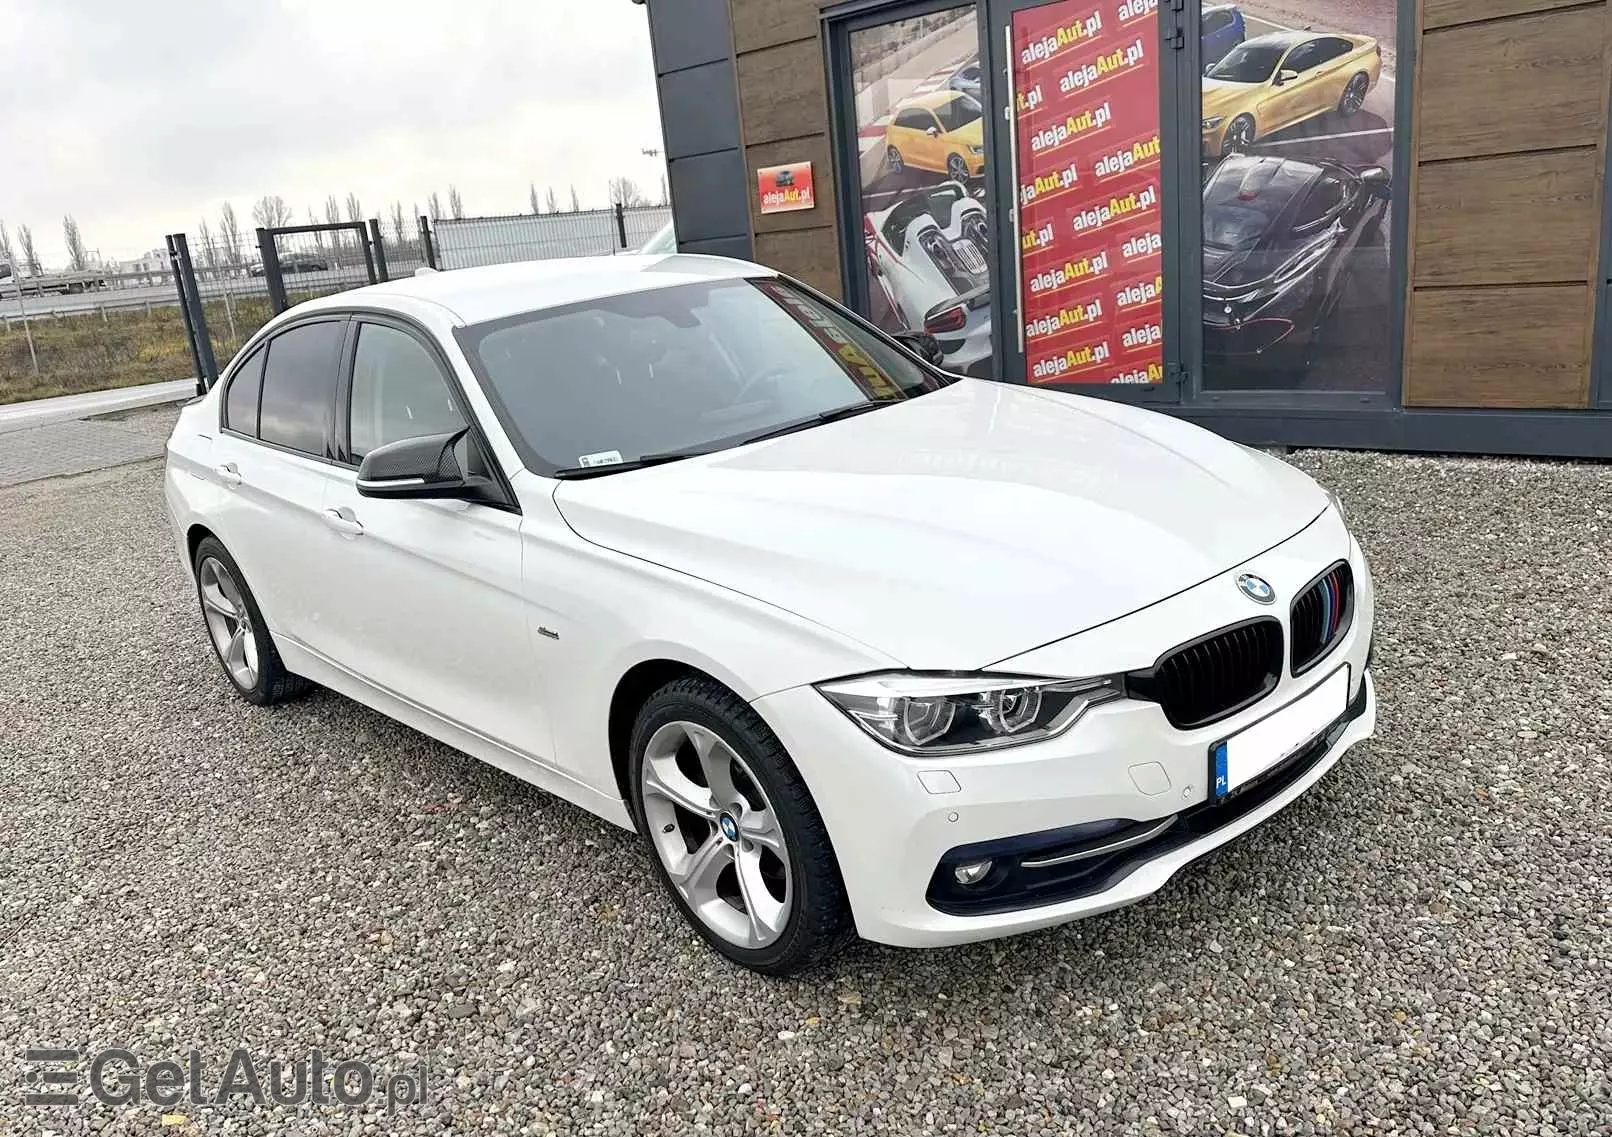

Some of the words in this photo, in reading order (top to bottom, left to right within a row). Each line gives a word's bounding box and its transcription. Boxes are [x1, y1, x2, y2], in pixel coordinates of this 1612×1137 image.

[1021, 10, 1103, 65] alejaAut.pl
[1059, 39, 1144, 93] alejaAut.pl
[1031, 102, 1112, 151] alejaAut.pl
[763, 186, 811, 205] alejaAut.pl
[1020, 163, 1078, 205] jaAut.pl
[1073, 184, 1156, 231] alejaAut.pl
[1122, 232, 1162, 258] aleja
[1030, 250, 1108, 292] alejaAut.pl
[1025, 299, 1103, 337] alejaAut.pl
[1122, 323, 1162, 347] aleja
[1033, 341, 1109, 377] alejaAut.pl
[1215, 775, 1227, 789] PL
